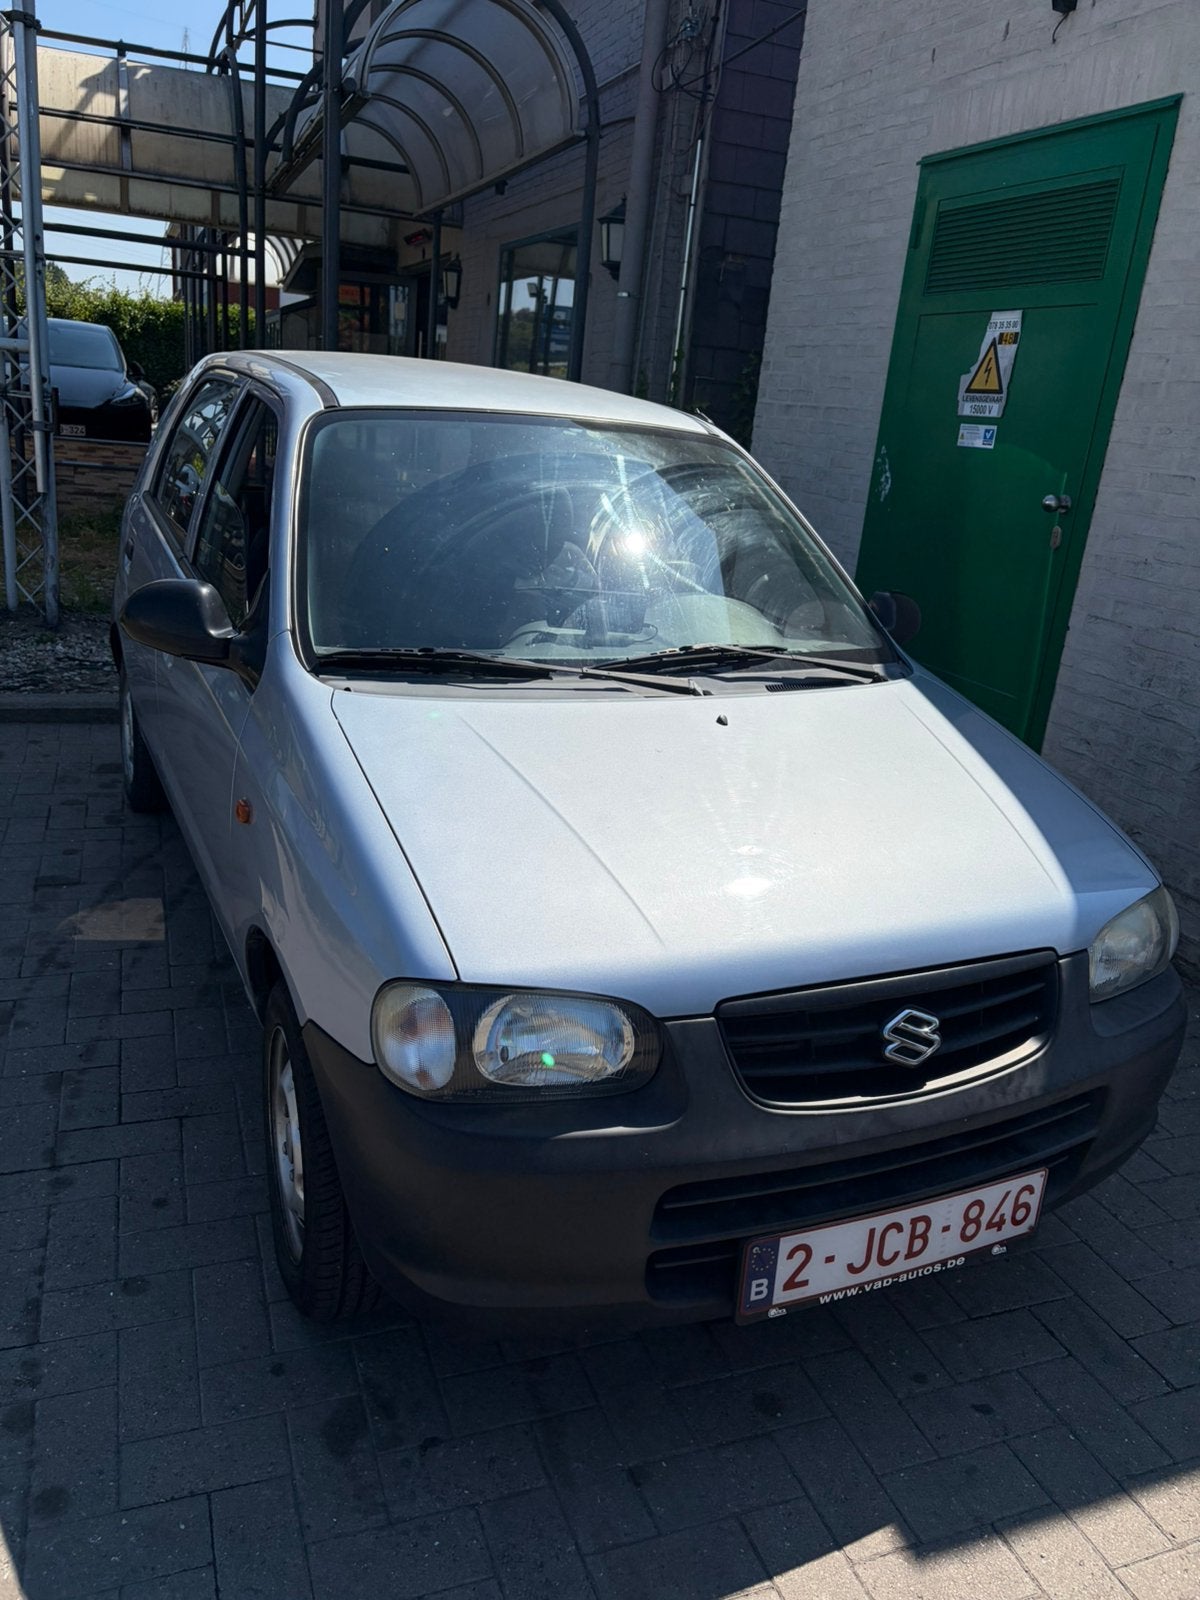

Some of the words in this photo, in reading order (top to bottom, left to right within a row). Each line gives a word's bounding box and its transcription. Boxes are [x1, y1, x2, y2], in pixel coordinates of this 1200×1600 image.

[969, 404, 987, 415] 15000
[988, 405, 994, 415] V
[782, 1184, 1035, 1292] 2-JCB-846
[751, 1278, 769, 1301] B
